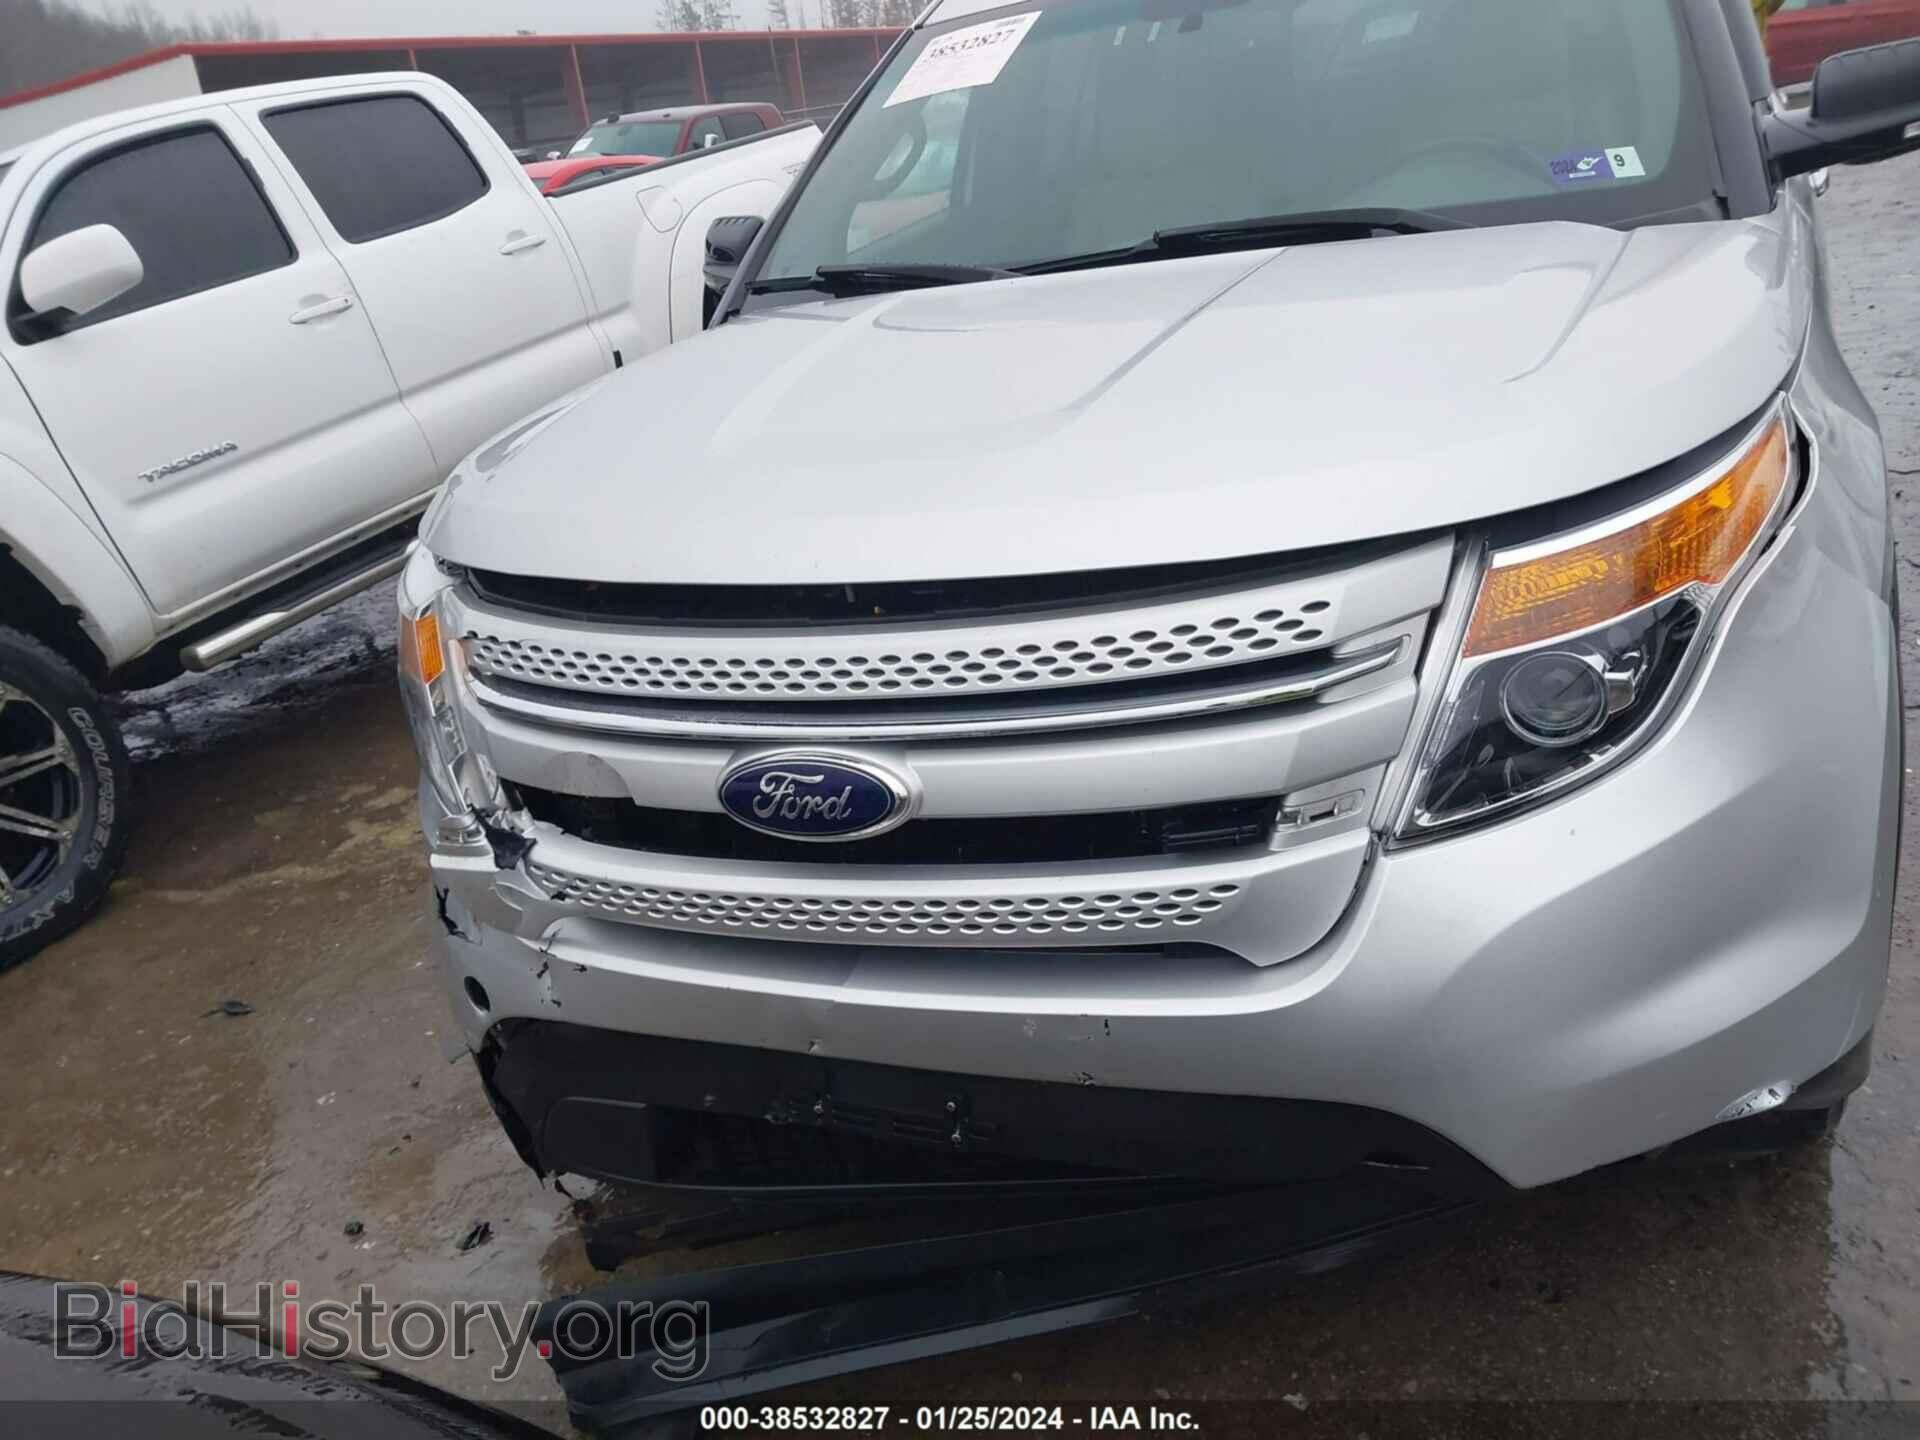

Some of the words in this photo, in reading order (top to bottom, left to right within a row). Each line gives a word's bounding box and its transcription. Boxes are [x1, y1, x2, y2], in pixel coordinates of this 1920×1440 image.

[1613, 154, 1626, 168] 9
[137, 440, 239, 482] TACOMA
[752, 771, 852, 820] Ford
